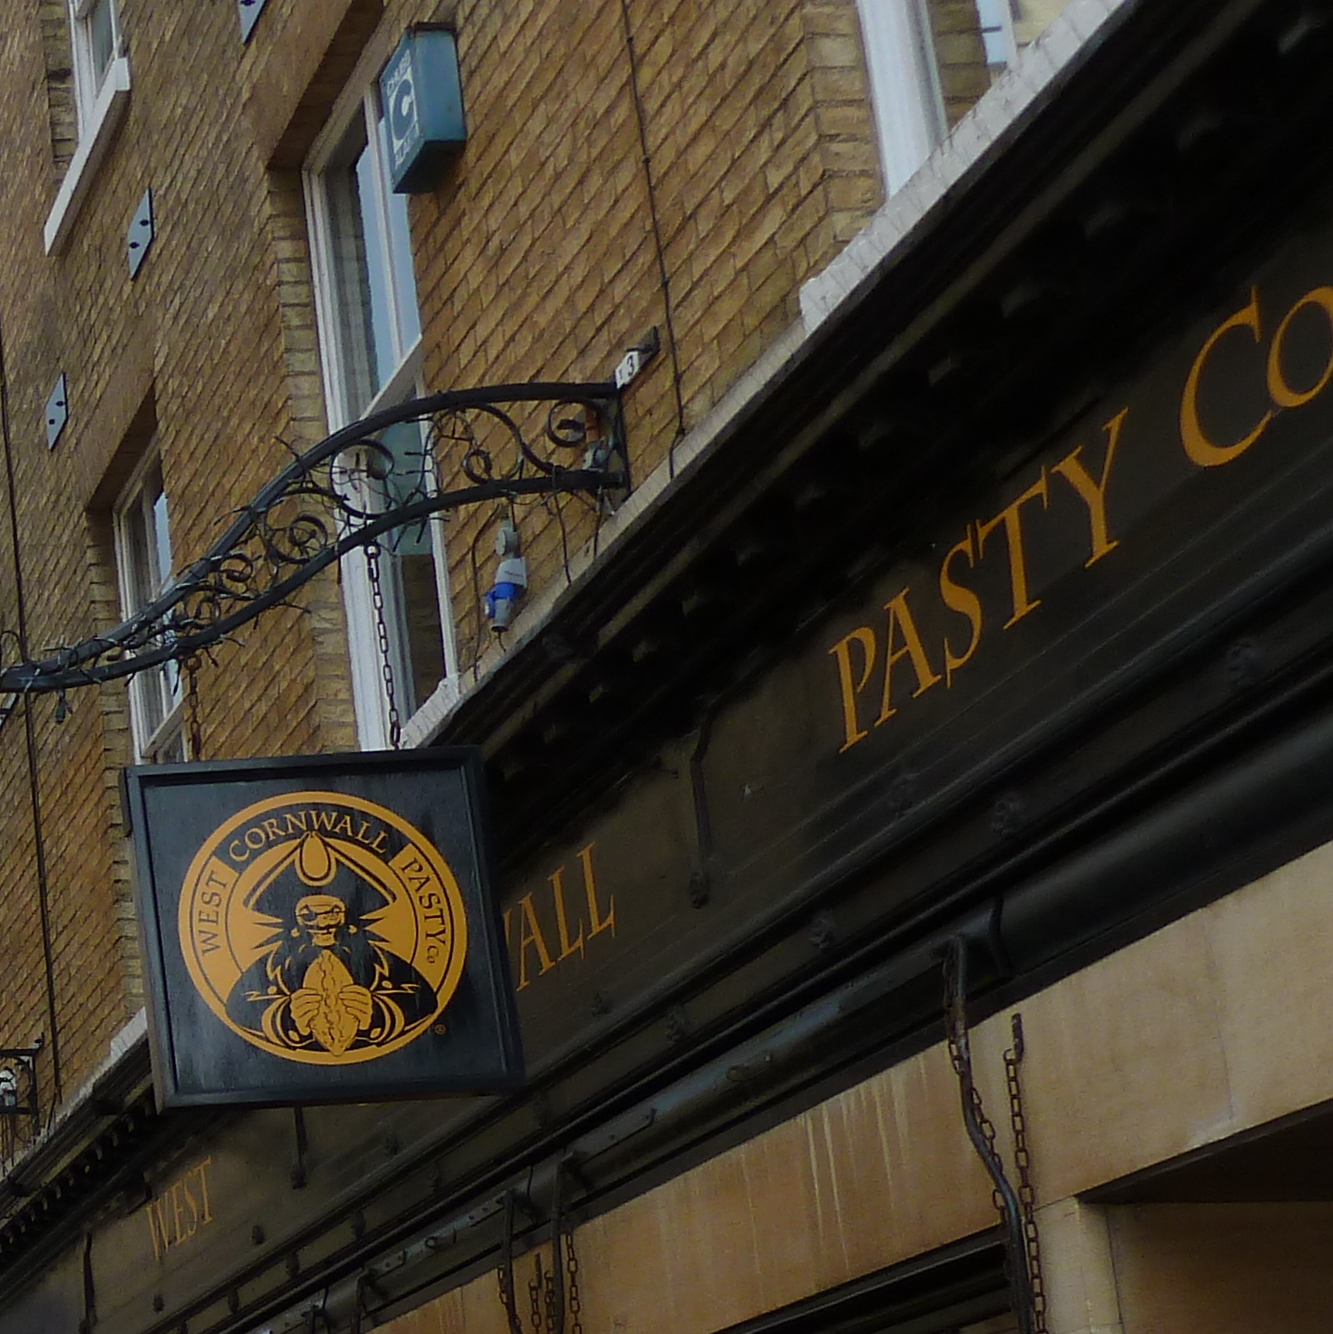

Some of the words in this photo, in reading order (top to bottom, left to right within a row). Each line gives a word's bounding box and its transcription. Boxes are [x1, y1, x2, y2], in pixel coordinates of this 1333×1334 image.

[828, 407, 1129, 755] PASTY
[198, 869, 229, 956] WEST
[229, 810, 388, 862] CORNWALL
[401, 857, 447, 945] PASTY
[145, 1154, 213, 1262] WEST
